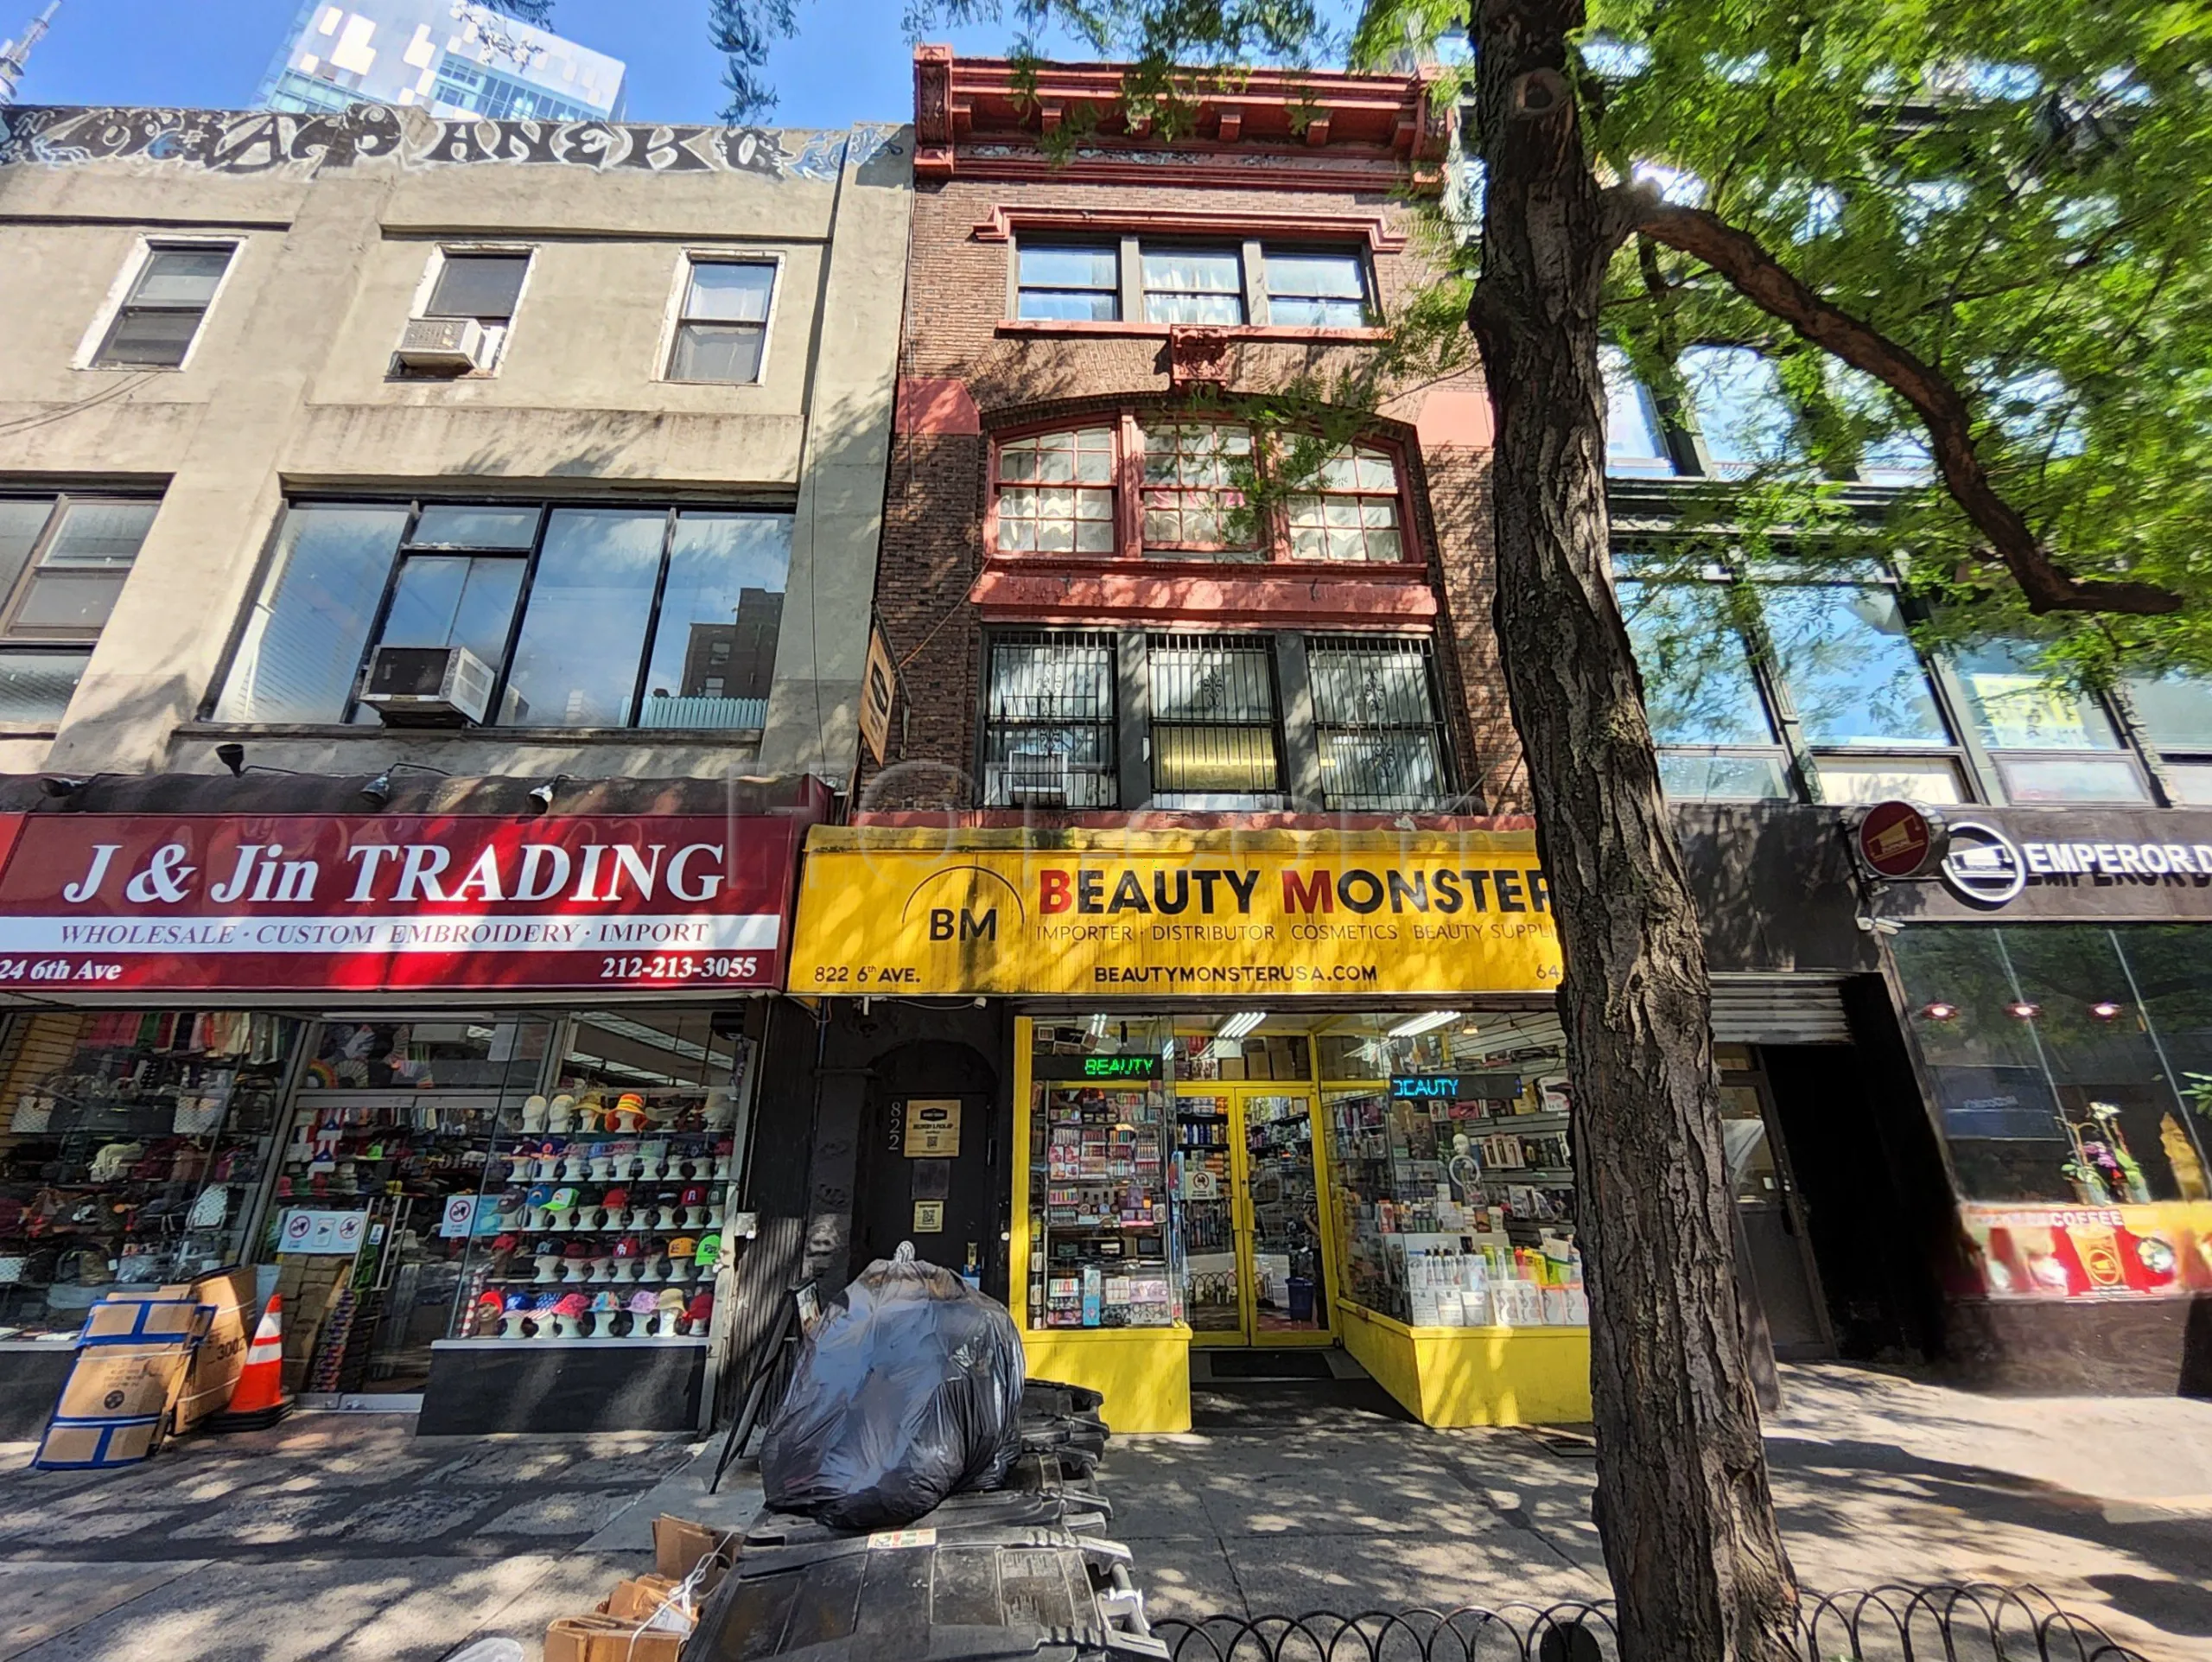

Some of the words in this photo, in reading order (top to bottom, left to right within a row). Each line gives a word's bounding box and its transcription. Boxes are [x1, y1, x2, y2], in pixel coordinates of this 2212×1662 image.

[2020, 843, 2191, 873] EMPEROR
[63, 844, 123, 903] J
[125, 844, 198, 903] &
[210, 844, 320, 903] Jin
[344, 844, 725, 901] TRADING
[1039, 869, 1261, 914] BEAUTY
[61, 924, 236, 945] WHOLESALE
[256, 924, 375, 945] CUSTOM
[389, 922, 582, 944] EMBROIDERY
[598, 921, 709, 943] IMPORT
[929, 908, 997, 941] BM
[1037, 925, 1134, 941] IMPORTER
[1152, 925, 1276, 941] DISTRIBUTOR
[1291, 924, 1398, 940] COSMETICS
[1413, 924, 1484, 939] BEAUTY
[29, 958, 71, 980] 6th
[72, 959, 123, 981] Ave
[601, 956, 757, 978] 212-213-3055
[814, 966, 849, 983] 822
[856, 965, 877, 983] 6th
[878, 967, 921, 984] AVE.
[1094, 965, 1377, 984] BEAUTYMONSTERUSA.COM
[1084, 1058, 1154, 1076] BEAUTY
[887, 1101, 902, 1150] 822
[2050, 1211, 2125, 1228] COFFEE
